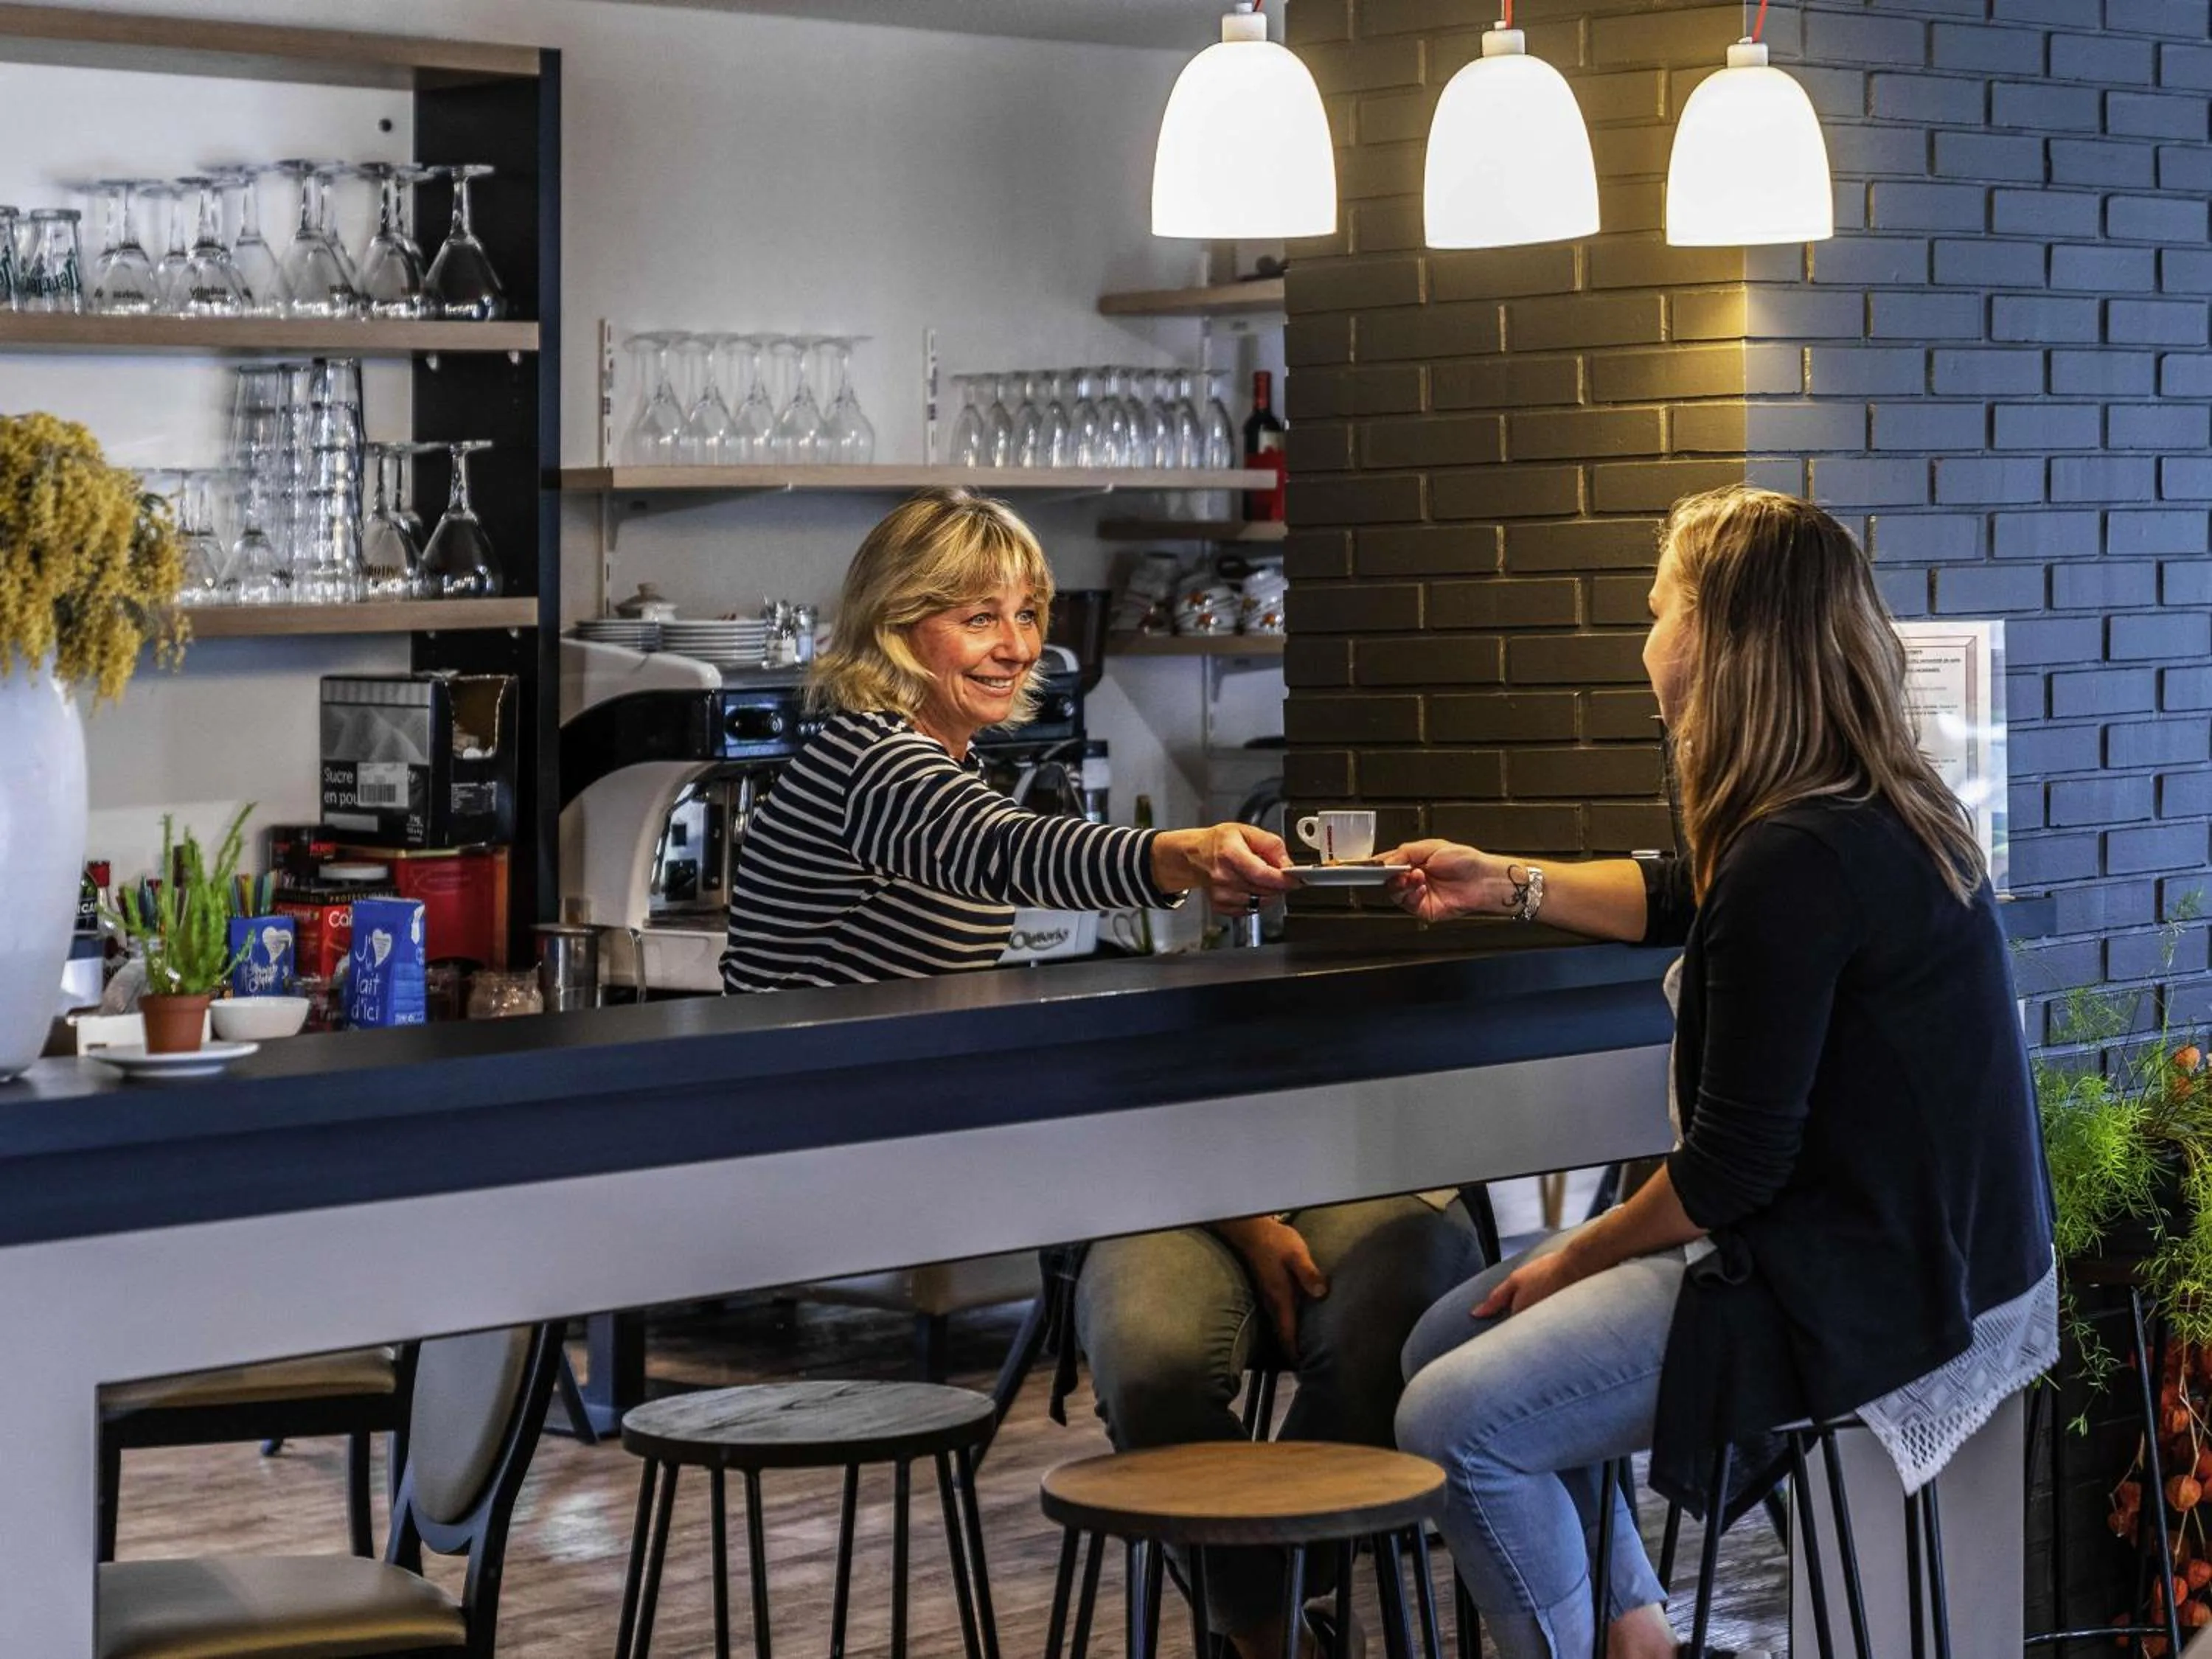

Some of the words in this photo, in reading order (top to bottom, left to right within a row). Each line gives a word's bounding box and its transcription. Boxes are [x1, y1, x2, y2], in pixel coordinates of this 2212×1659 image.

[324, 767, 353, 785] Sucre
[324, 791, 337, 804] en
[339, 792, 358, 807] pou
[355, 967, 380, 995] lait
